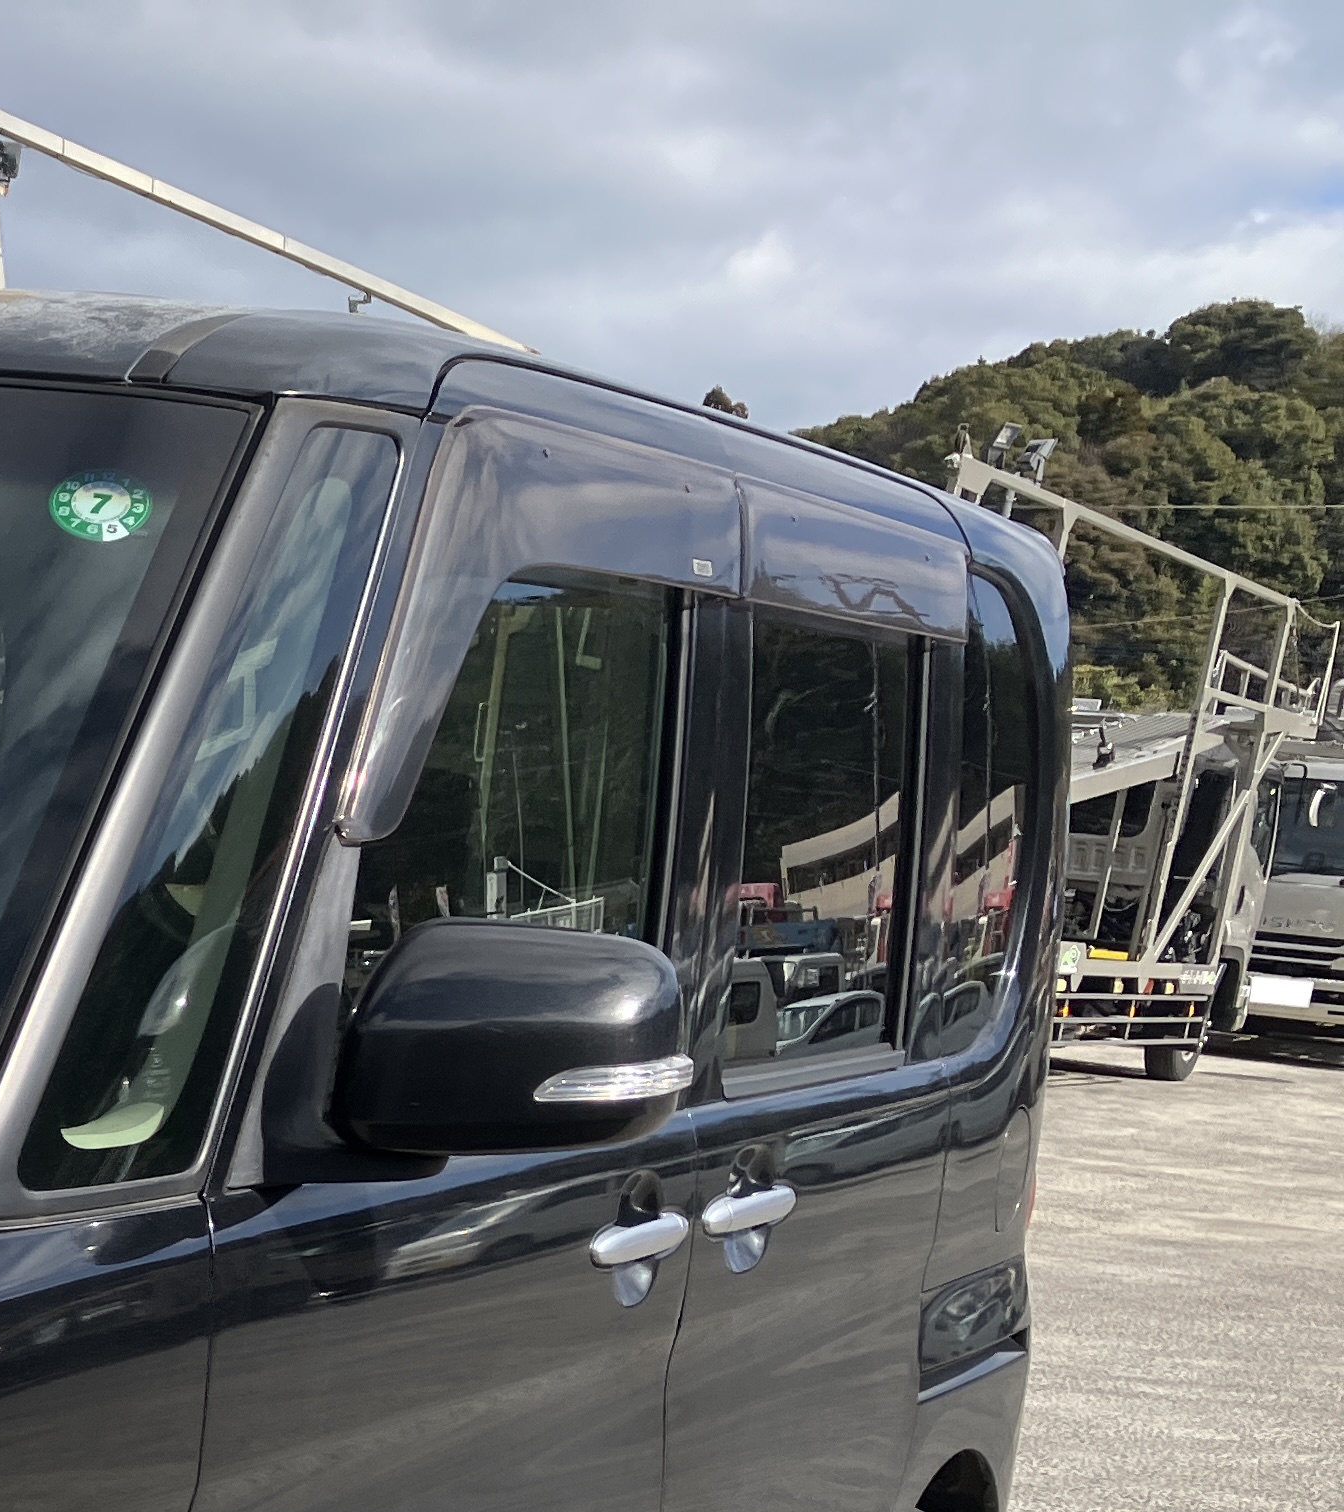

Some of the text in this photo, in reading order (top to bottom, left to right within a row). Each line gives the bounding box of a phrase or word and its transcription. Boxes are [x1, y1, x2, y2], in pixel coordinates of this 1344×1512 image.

[66, 481, 80, 490] 10
[132, 489, 144, 499] 2
[90, 492, 113, 514] 7
[132, 503, 144, 513] 3
[70, 518, 81, 527] 7
[122, 516, 135, 525] 4
[86, 524, 99, 534] 6
[106, 524, 118, 533] 5
